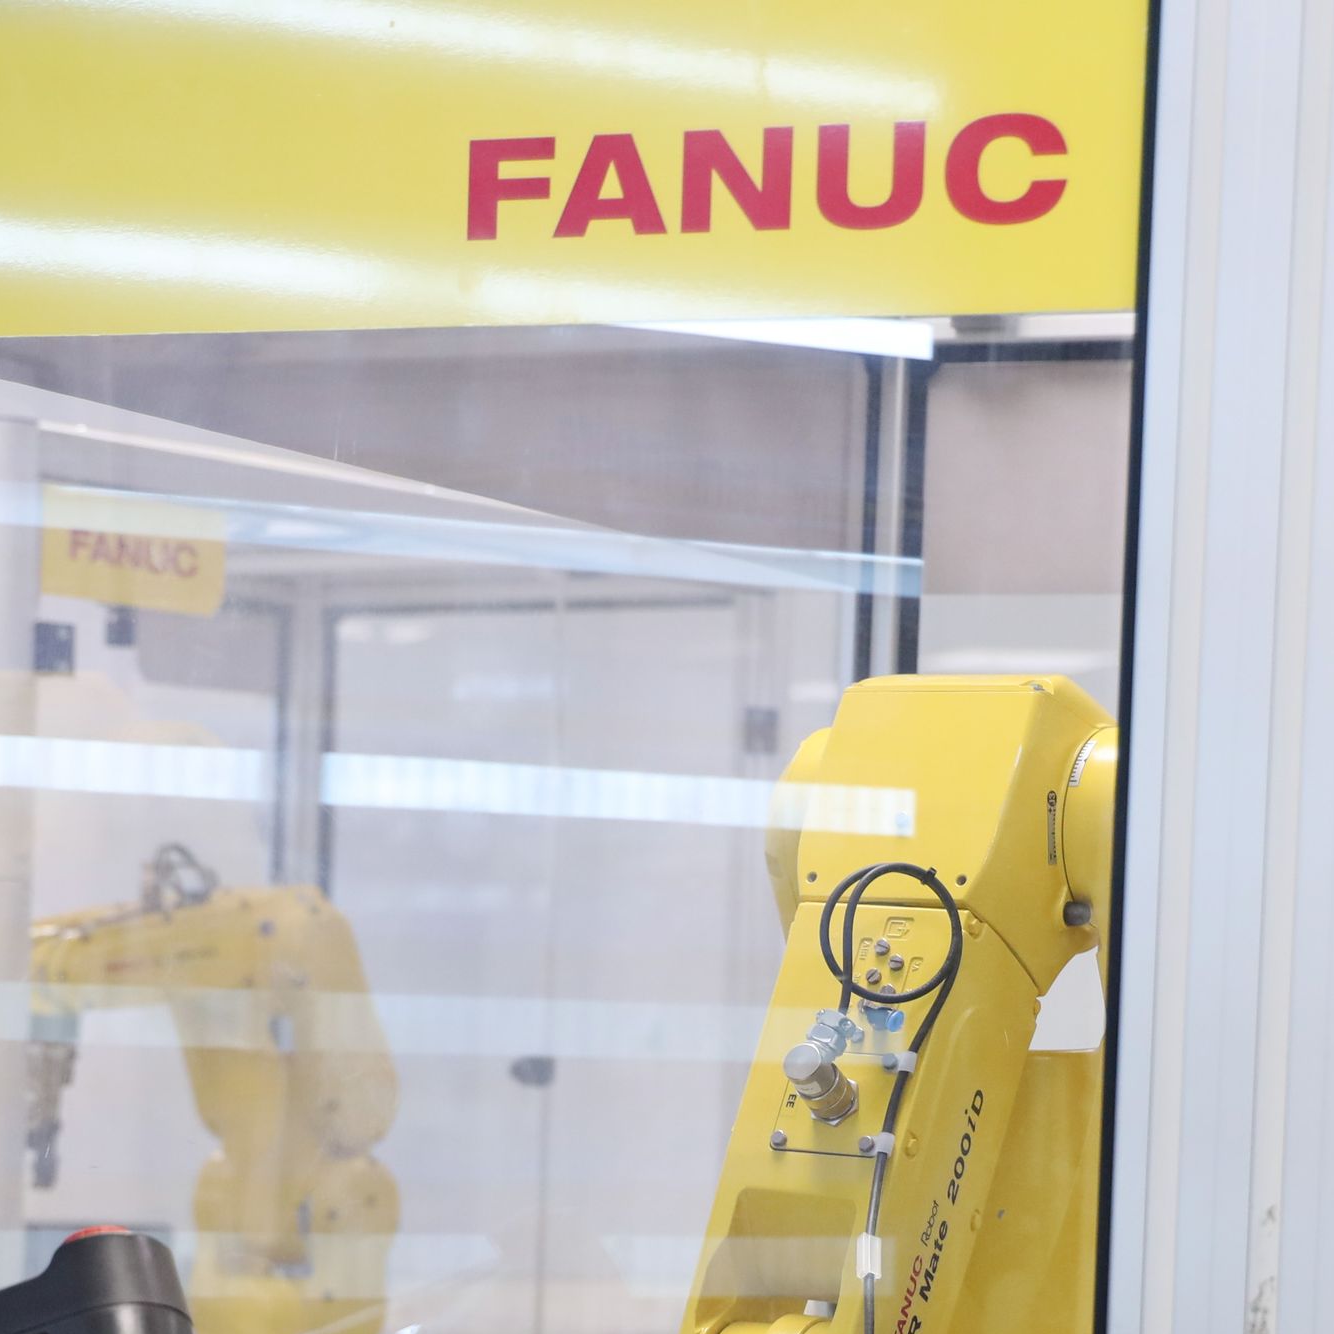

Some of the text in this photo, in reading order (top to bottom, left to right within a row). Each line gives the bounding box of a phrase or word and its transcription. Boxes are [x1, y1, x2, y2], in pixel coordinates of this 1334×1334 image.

[467, 112, 1069, 241] FANUC
[69, 529, 199, 579] FANUC
[786, 1094, 797, 1108] EE
[919, 1219, 949, 1303] Mate
[947, 1088, 984, 1206] 200iD
[920, 1199, 940, 1247] Robot
